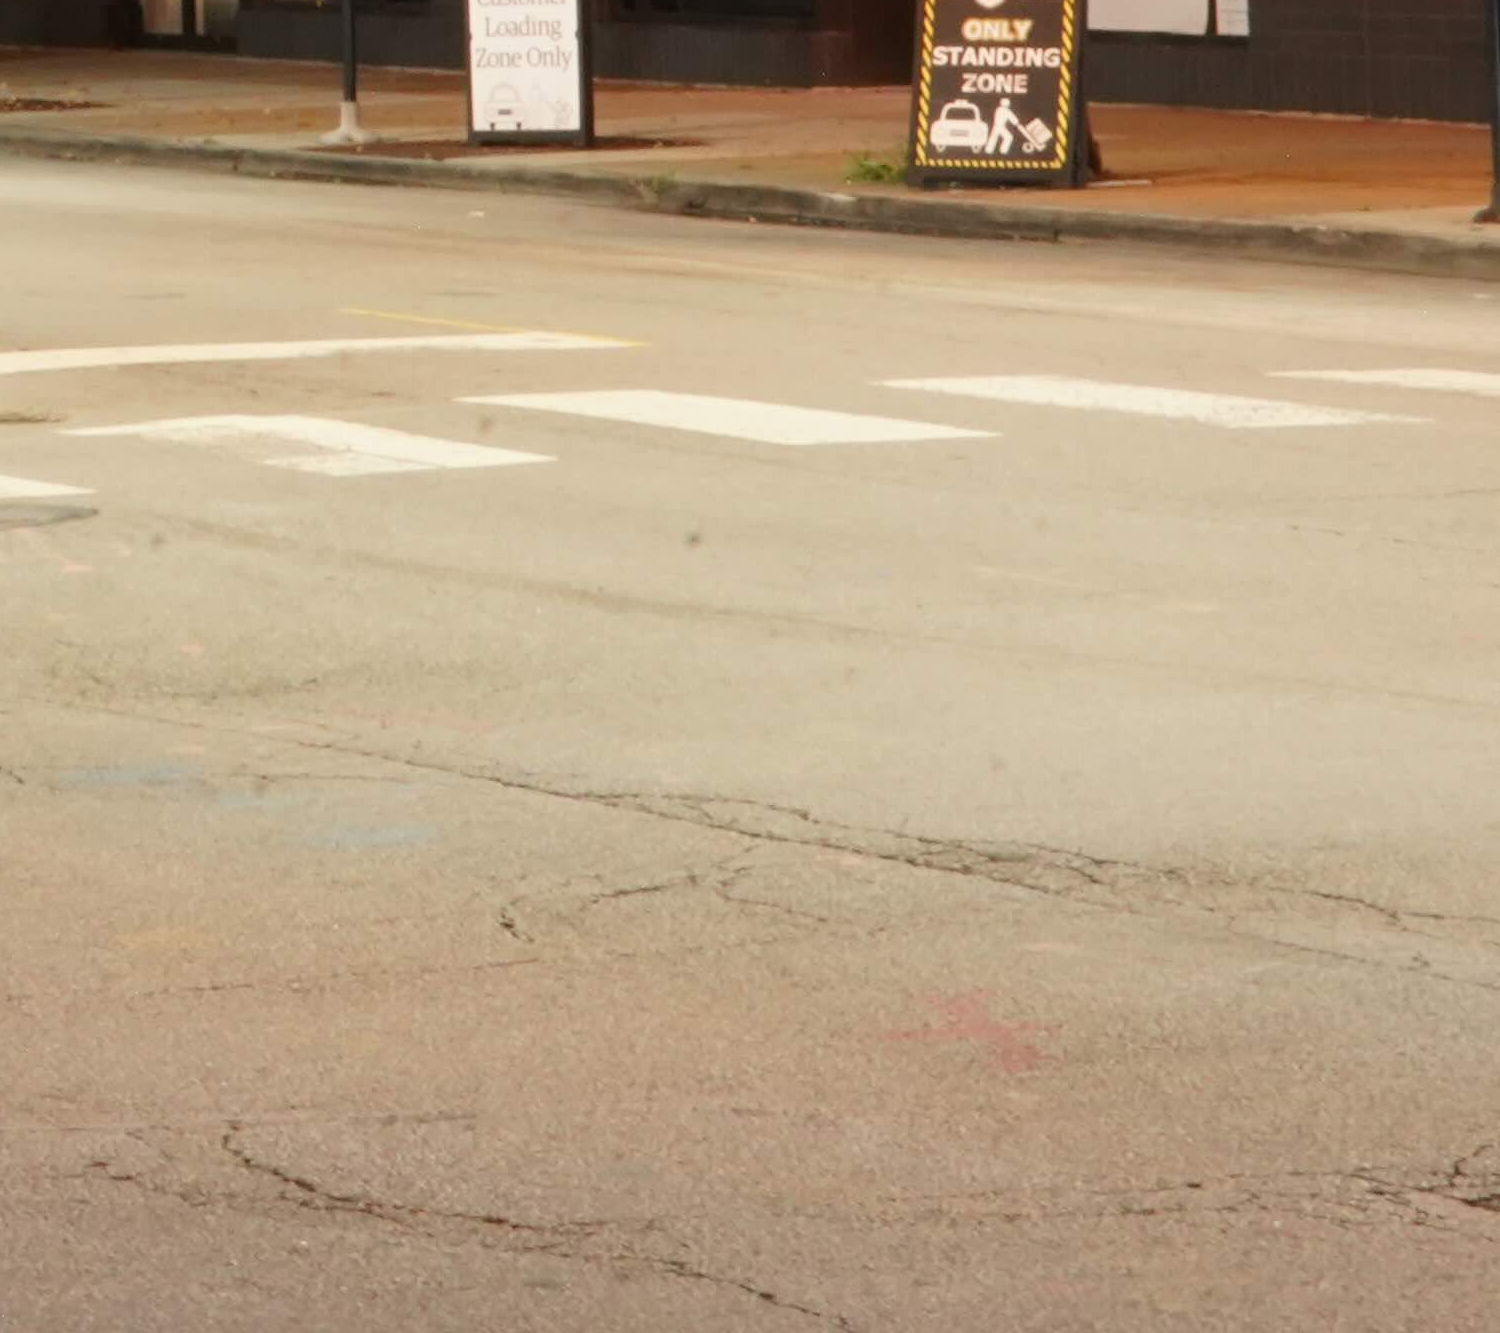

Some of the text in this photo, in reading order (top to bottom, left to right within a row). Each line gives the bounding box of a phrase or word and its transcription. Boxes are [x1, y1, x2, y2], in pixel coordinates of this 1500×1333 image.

[484, 16, 563, 40] Loading
[961, 18, 1033, 42] ONLY
[476, 44, 572, 71] Zone Only
[932, 46, 1061, 68] STANDING
[961, 72, 1029, 94] ZONE
